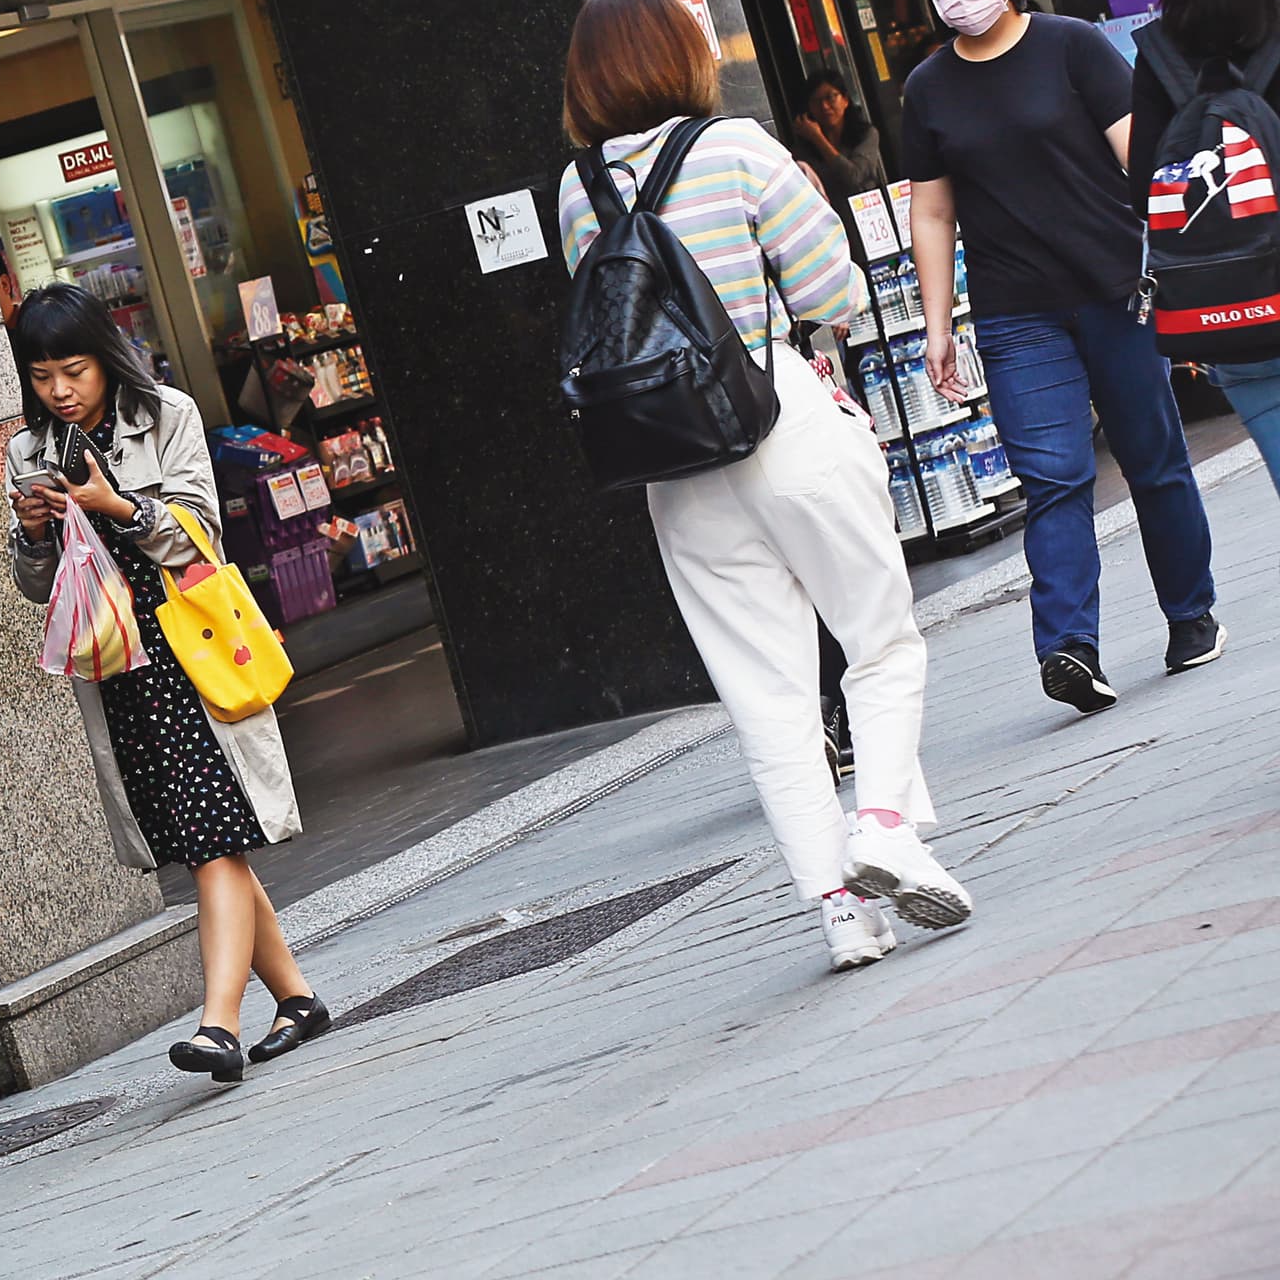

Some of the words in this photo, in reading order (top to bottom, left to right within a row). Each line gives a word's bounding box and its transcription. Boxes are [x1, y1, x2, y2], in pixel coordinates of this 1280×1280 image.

[1200, 309, 1242, 326] POLO
[1243, 304, 1277, 320] USA
[830, 912, 856, 927] FILA
